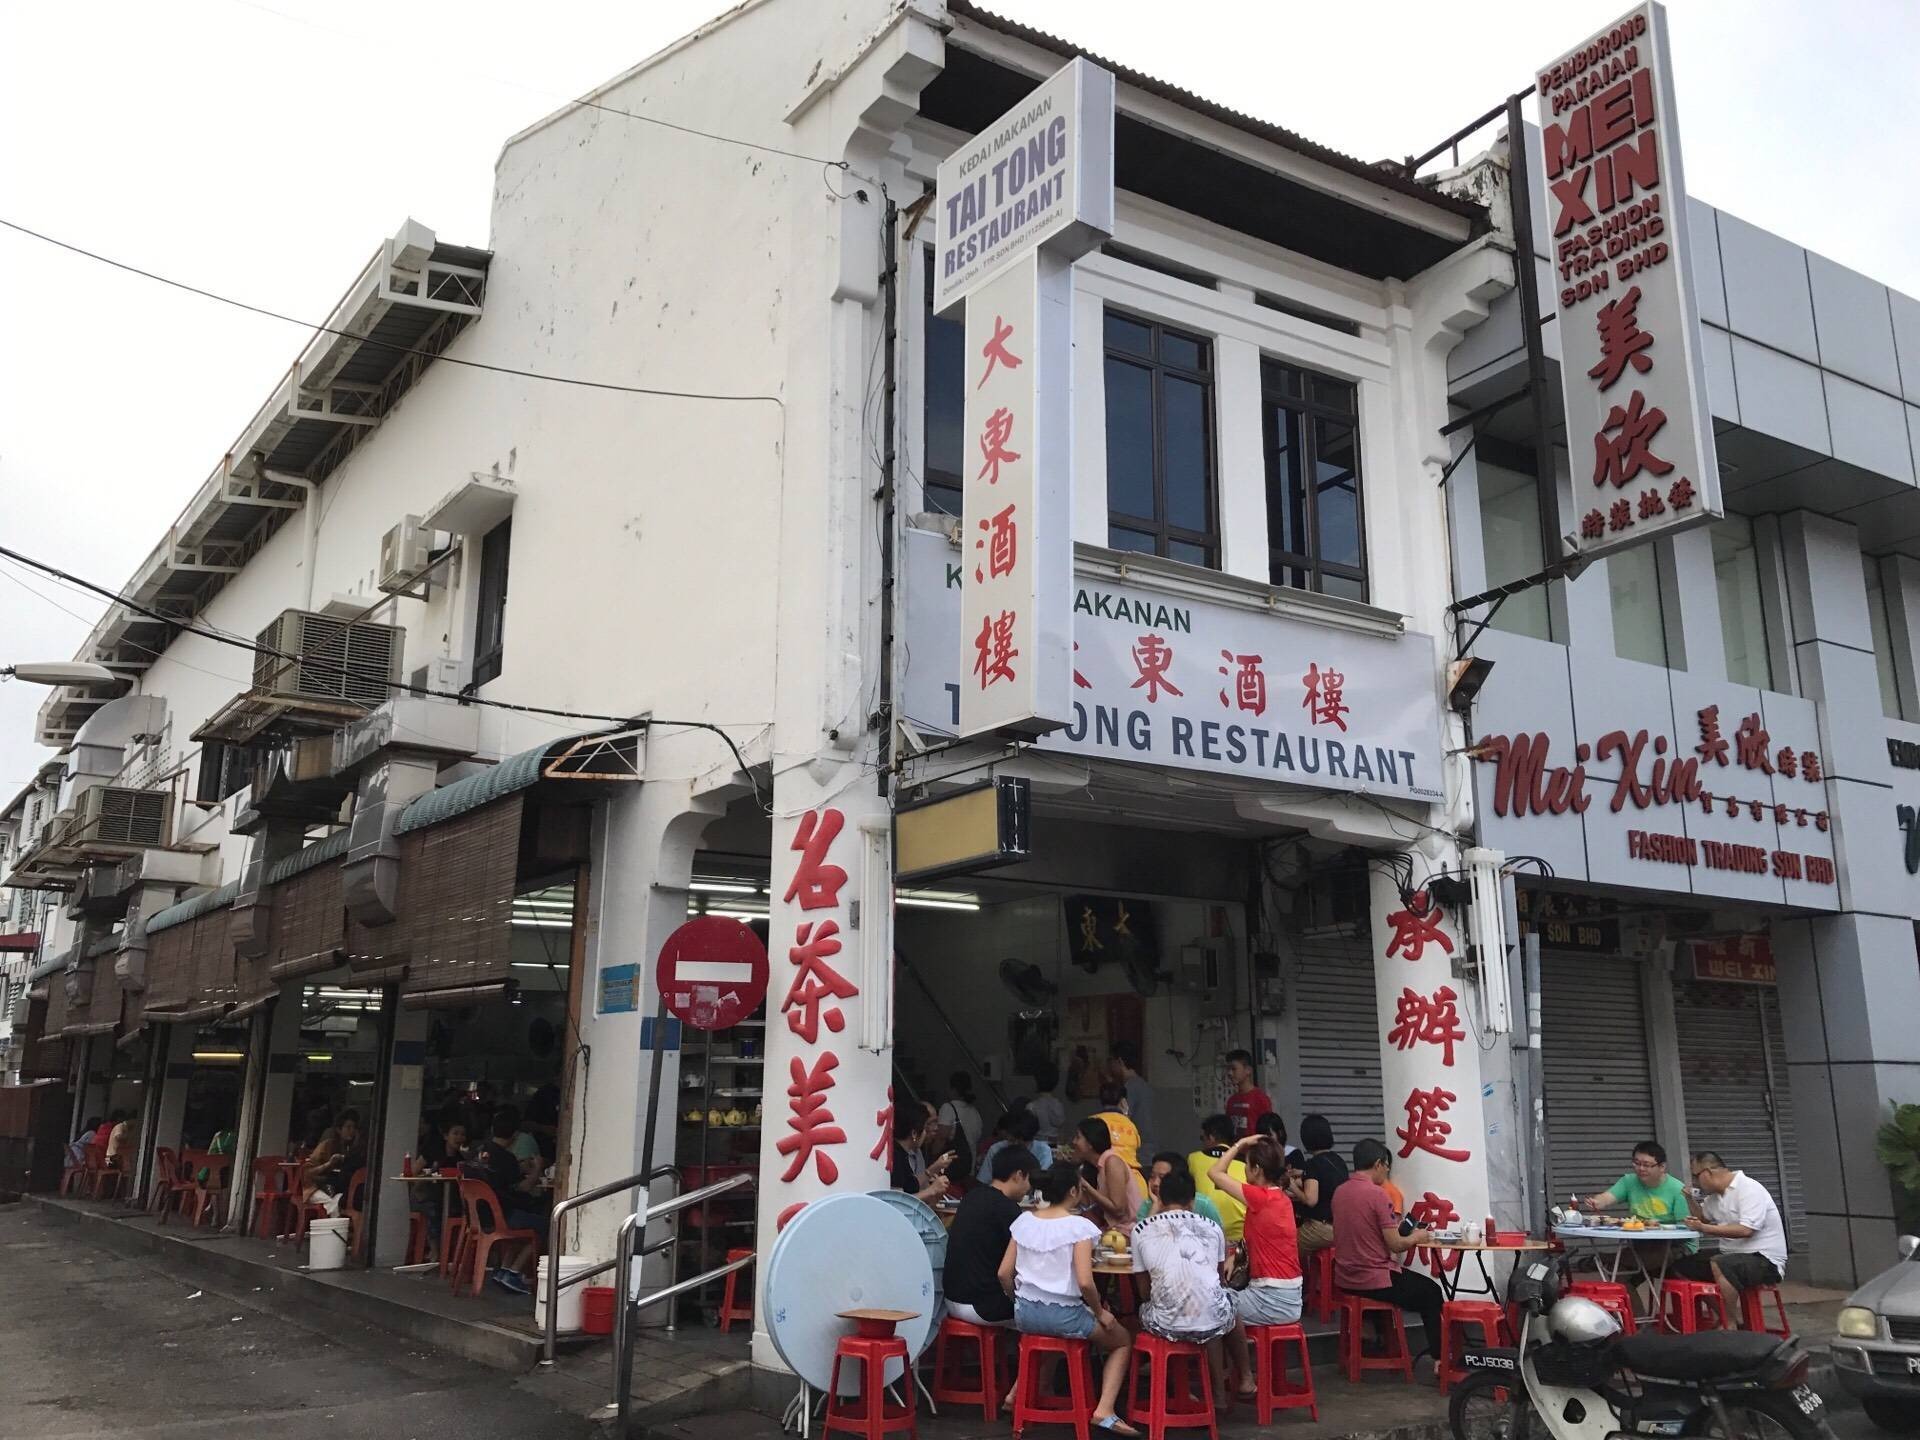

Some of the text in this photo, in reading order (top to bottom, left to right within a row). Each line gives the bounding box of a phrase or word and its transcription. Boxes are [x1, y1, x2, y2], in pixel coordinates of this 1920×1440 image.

[1539, 14, 1646, 97] PEMBORONG
[1552, 45, 1638, 116] PAKAIAN
[959, 96, 1052, 179] KEDAI MAKANAN
[1543, 67, 1655, 180] MEI
[946, 115, 1066, 240] TAI TONG
[1550, 128, 1659, 238] XIN
[944, 169, 1066, 280] RESTAURANT
[1557, 193, 1660, 262] FASHION
[1559, 216, 1665, 281] TRADING
[1560, 241, 1668, 308] SDN BHD
[973, 315, 1023, 691] 大東酒樓
[1073, 590, 1192, 634] AKANAN
[1063, 700, 1417, 788] ONG RESTAURANT
[1478, 728, 1703, 818] Mei Xin
[1628, 829, 1835, 886] FASHION TRADING SDN BHD
[1545, 922, 1570, 944] SDN
[1577, 926, 1601, 946] BHD
[1708, 959, 1743, 978] WEI
[775, 808, 860, 1233] 名茶美
